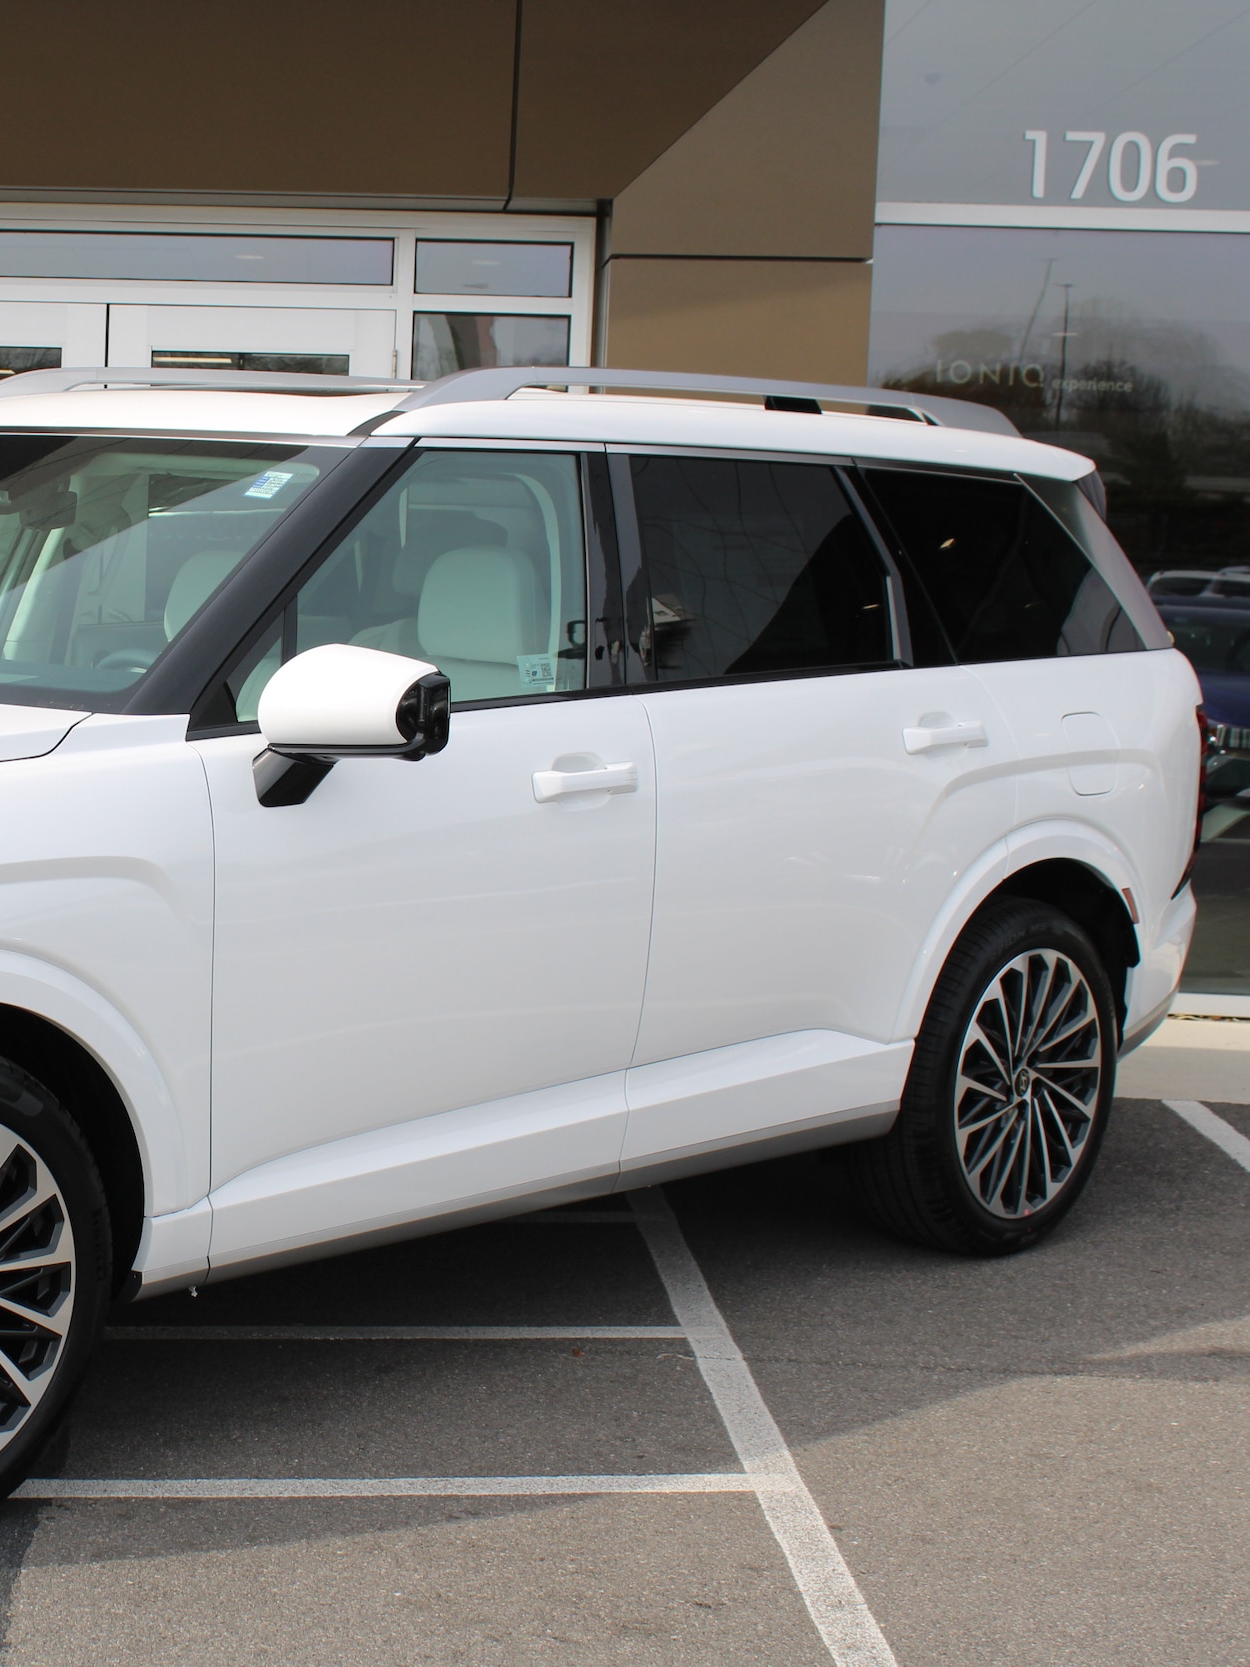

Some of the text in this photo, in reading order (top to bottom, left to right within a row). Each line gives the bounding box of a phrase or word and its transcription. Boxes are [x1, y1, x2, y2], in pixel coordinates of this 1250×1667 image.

[1023, 129, 1199, 204] 1706
[935, 358, 1134, 393] IONIQ experience
